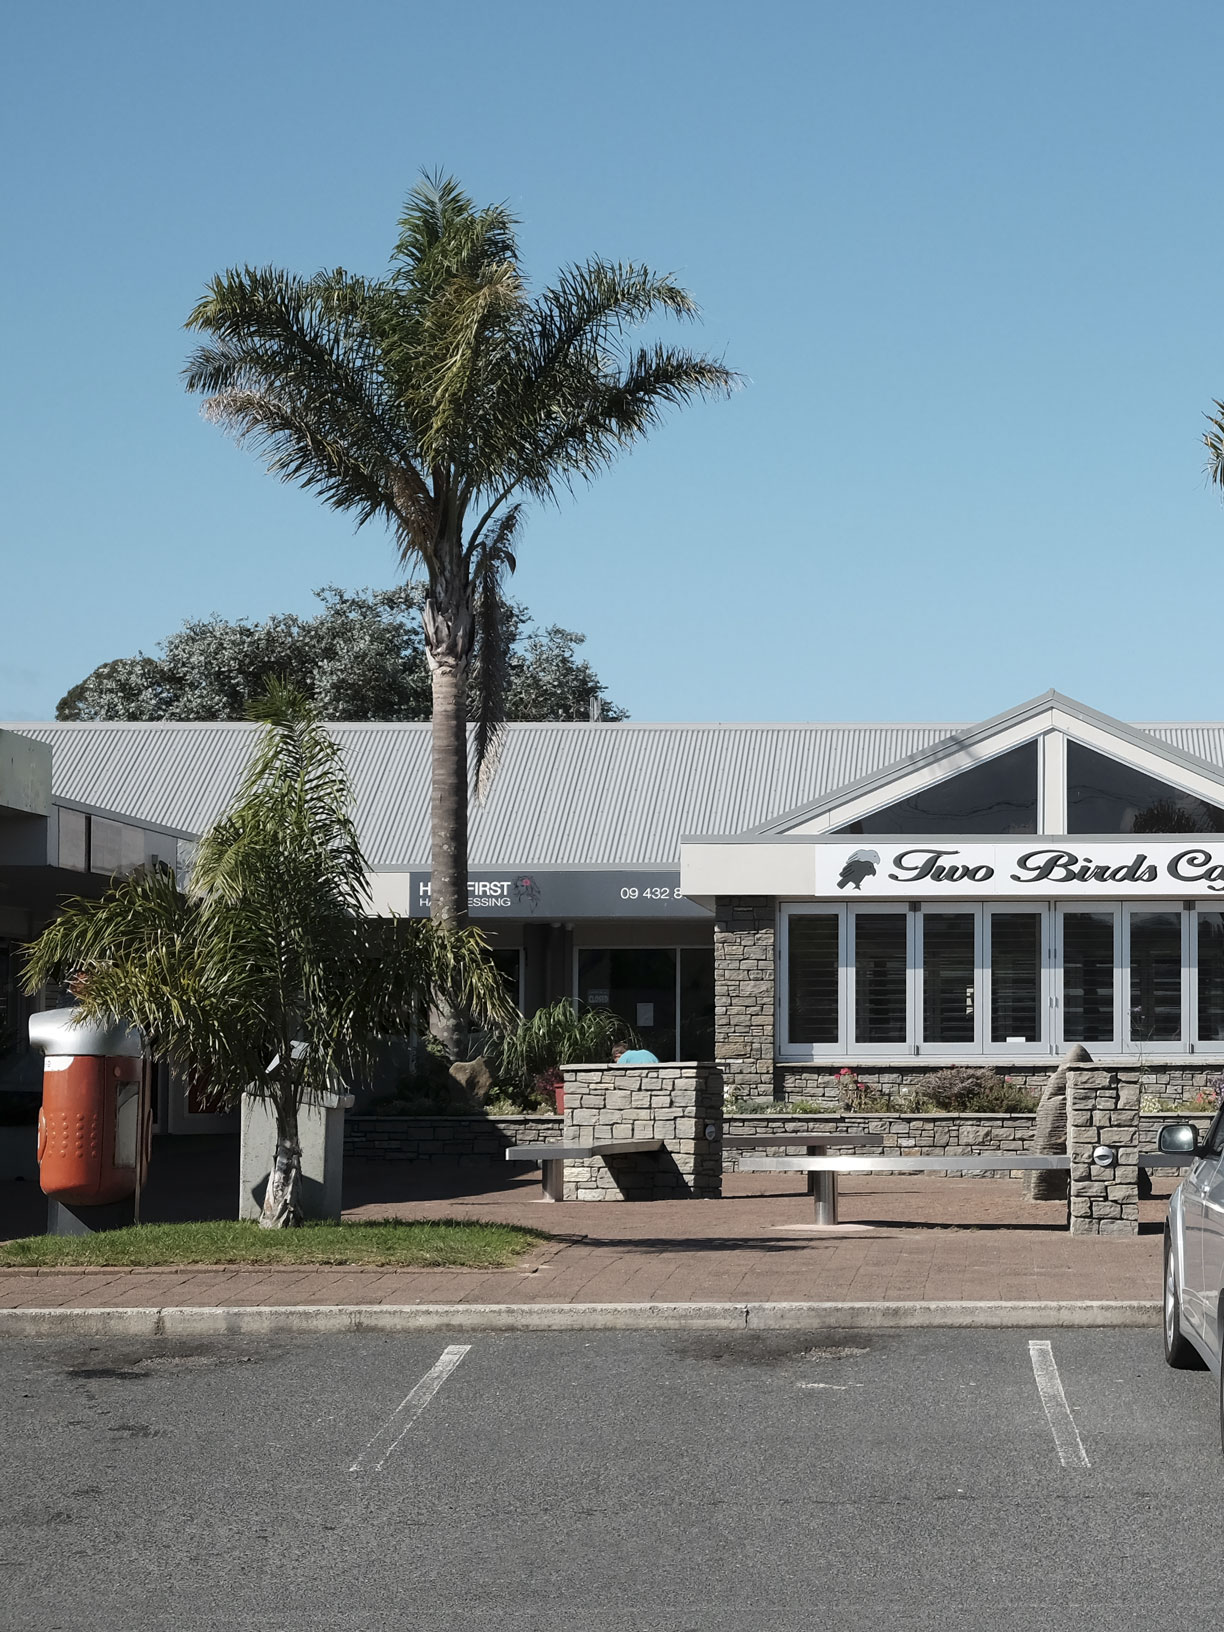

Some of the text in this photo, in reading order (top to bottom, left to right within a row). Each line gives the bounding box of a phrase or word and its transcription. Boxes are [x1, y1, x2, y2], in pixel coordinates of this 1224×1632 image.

[888, 848, 995, 882] Two
[1010, 848, 1158, 883] Birds
[467, 882, 511, 896] FIRST
[620, 887, 639, 899] 09
[642, 887, 670, 899] 432
[419, 897, 511, 907] HESSING
